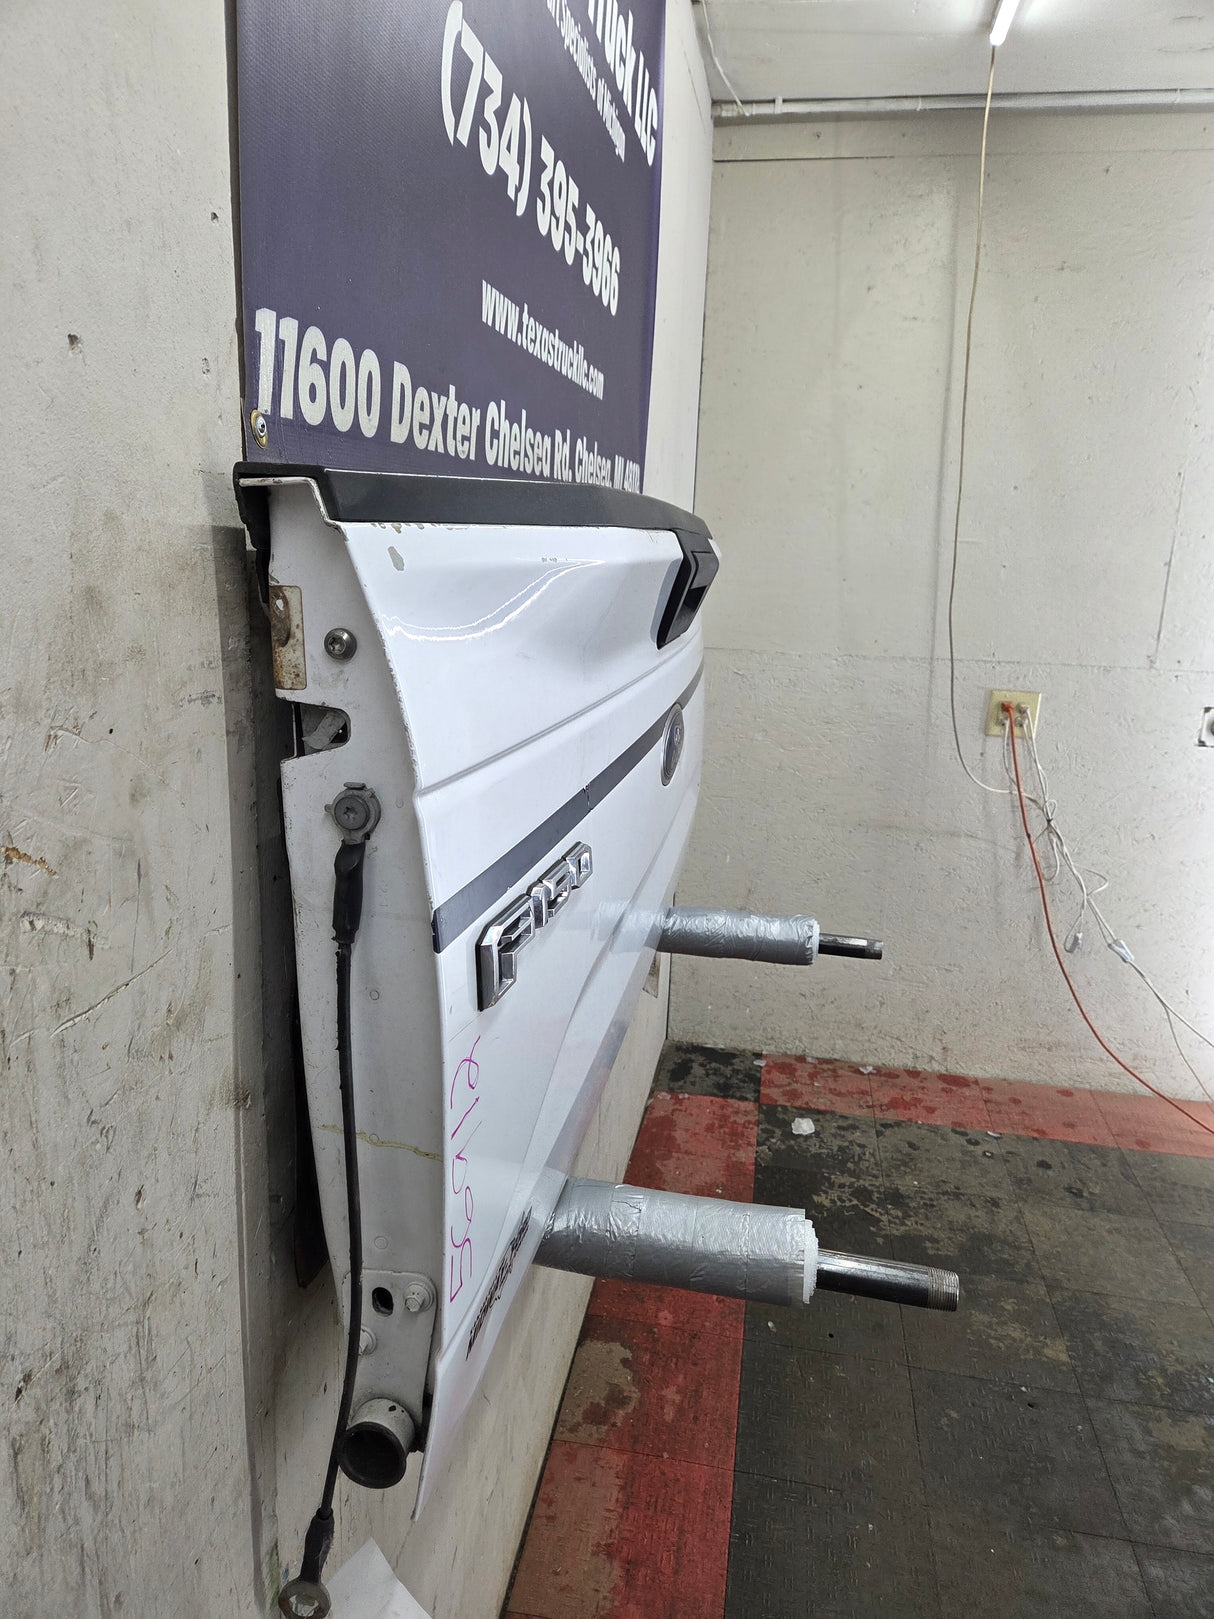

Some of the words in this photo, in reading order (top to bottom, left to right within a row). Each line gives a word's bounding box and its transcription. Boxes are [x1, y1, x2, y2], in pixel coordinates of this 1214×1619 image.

[441, 0, 532, 217] (734)
[537, 134, 621, 317] 395-3966
[634, 50, 658, 167] LLC
[255, 307, 381, 438] 11600
[390, 360, 481, 462] Dexter
[485, 399, 552, 478] Chelsea
[553, 428, 573, 483] Rd.
[481, 279, 604, 401] www.texastruckllc.com
